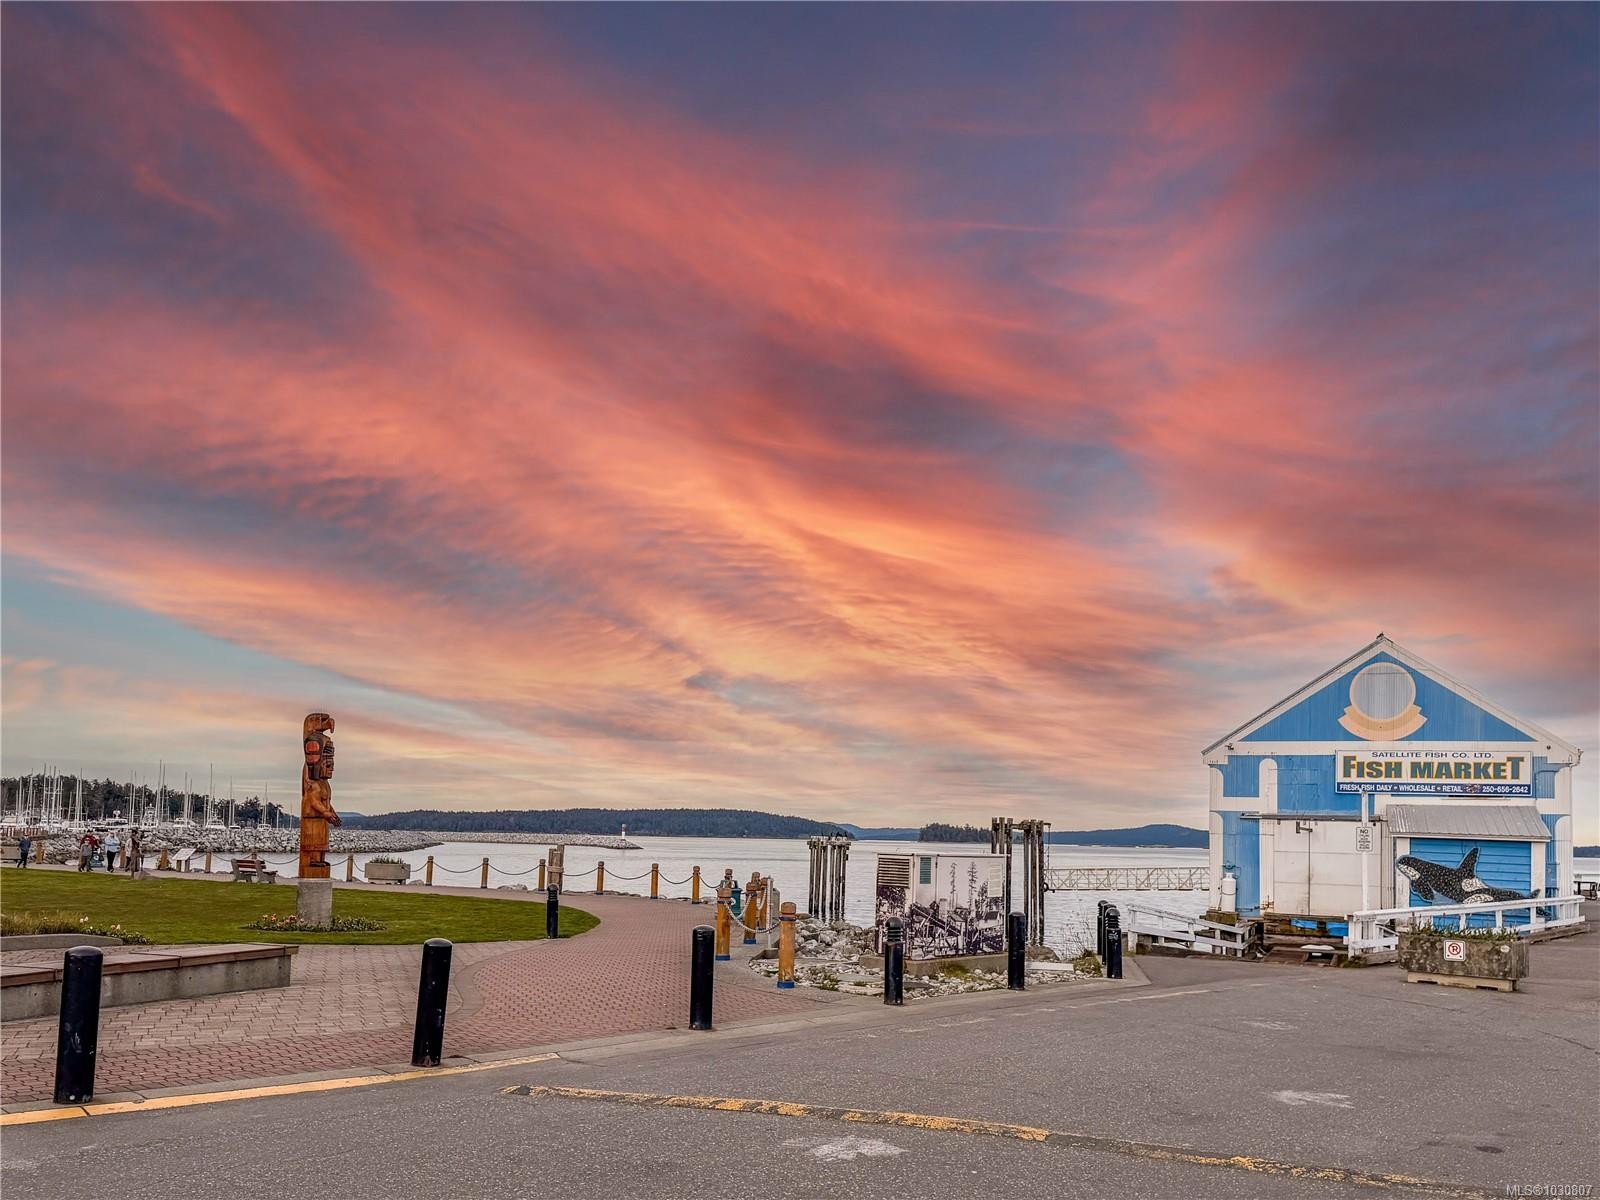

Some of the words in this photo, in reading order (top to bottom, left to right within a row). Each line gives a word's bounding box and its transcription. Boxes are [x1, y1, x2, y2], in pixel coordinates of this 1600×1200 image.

[1343, 755, 1403, 779] FISH
[1410, 756, 1525, 780] MARKET
[1399, 784, 1436, 792] WHOLESALE
